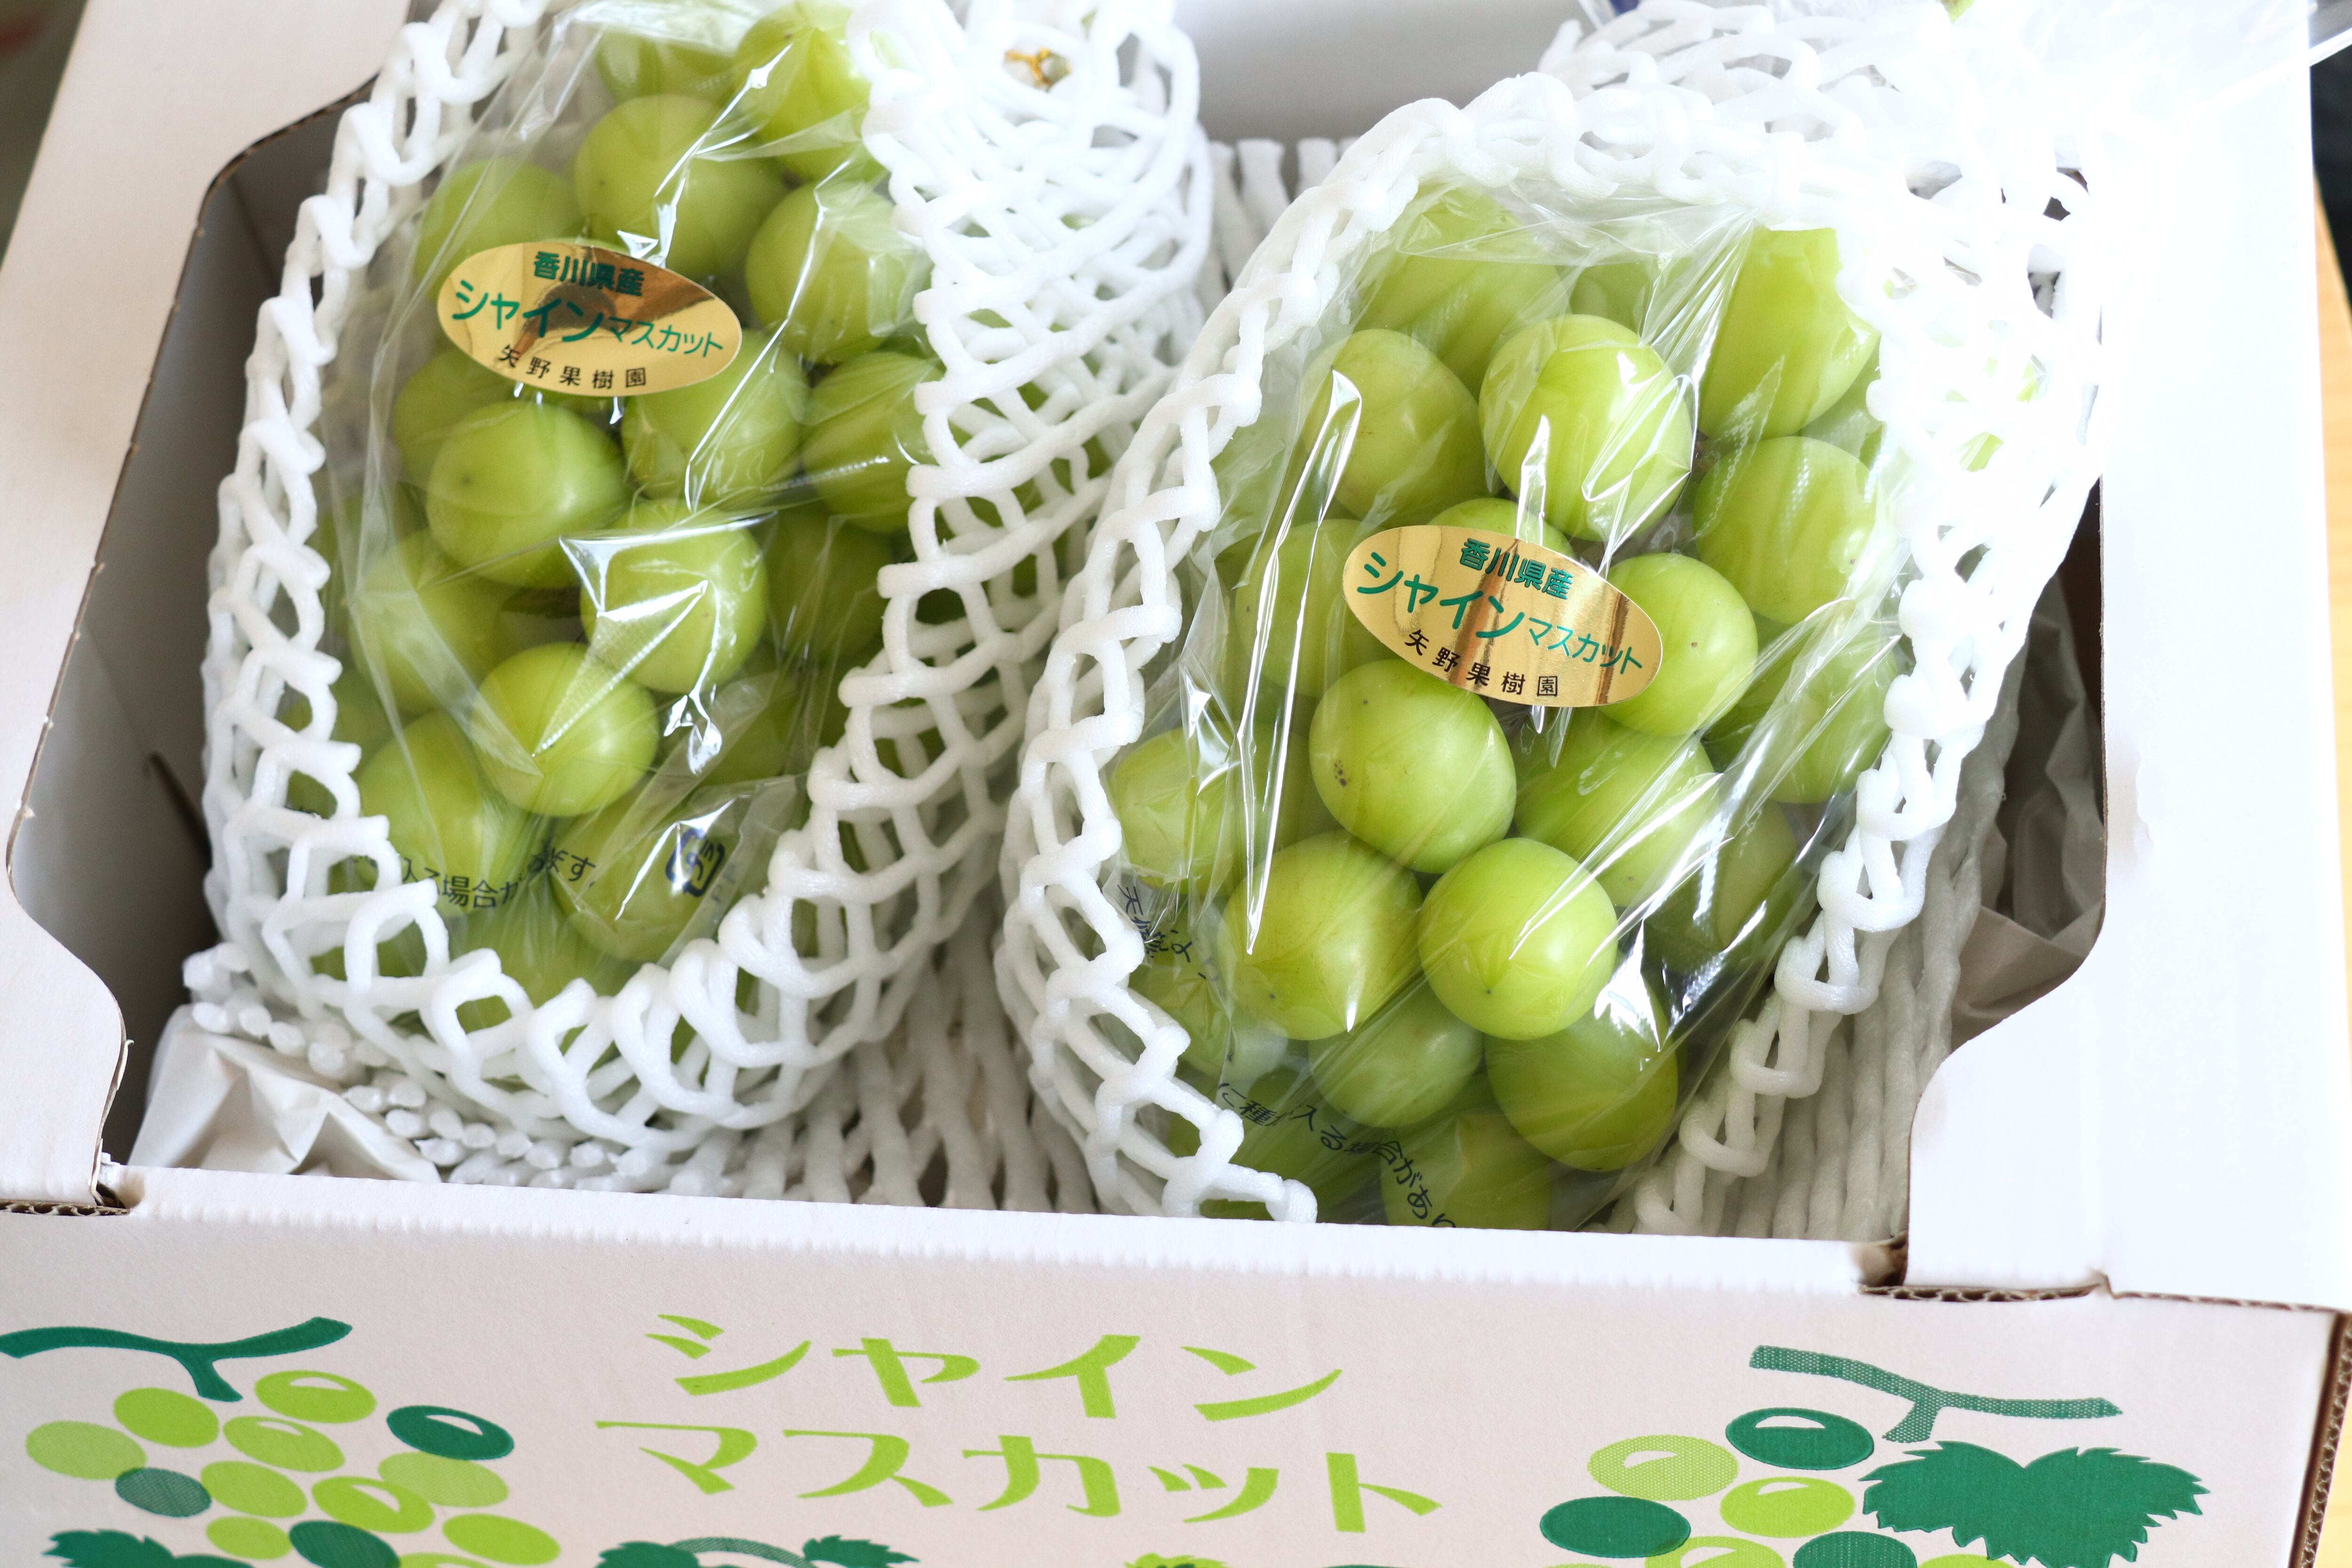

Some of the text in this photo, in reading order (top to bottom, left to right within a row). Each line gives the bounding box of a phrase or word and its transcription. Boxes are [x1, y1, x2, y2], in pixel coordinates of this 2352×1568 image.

[533, 251, 645, 297] 香川県産
[452, 279, 723, 358] シャインマスカット
[498, 344, 646, 390] 矢野果樹園
[1459, 537, 1574, 600] 香川県産
[1357, 551, 1643, 675] シャインマスカット
[1404, 629, 1559, 698] 矢野果樹園
[644, 1313, 1343, 1423] シャイン
[594, 1420, 1443, 1534] マスカット
